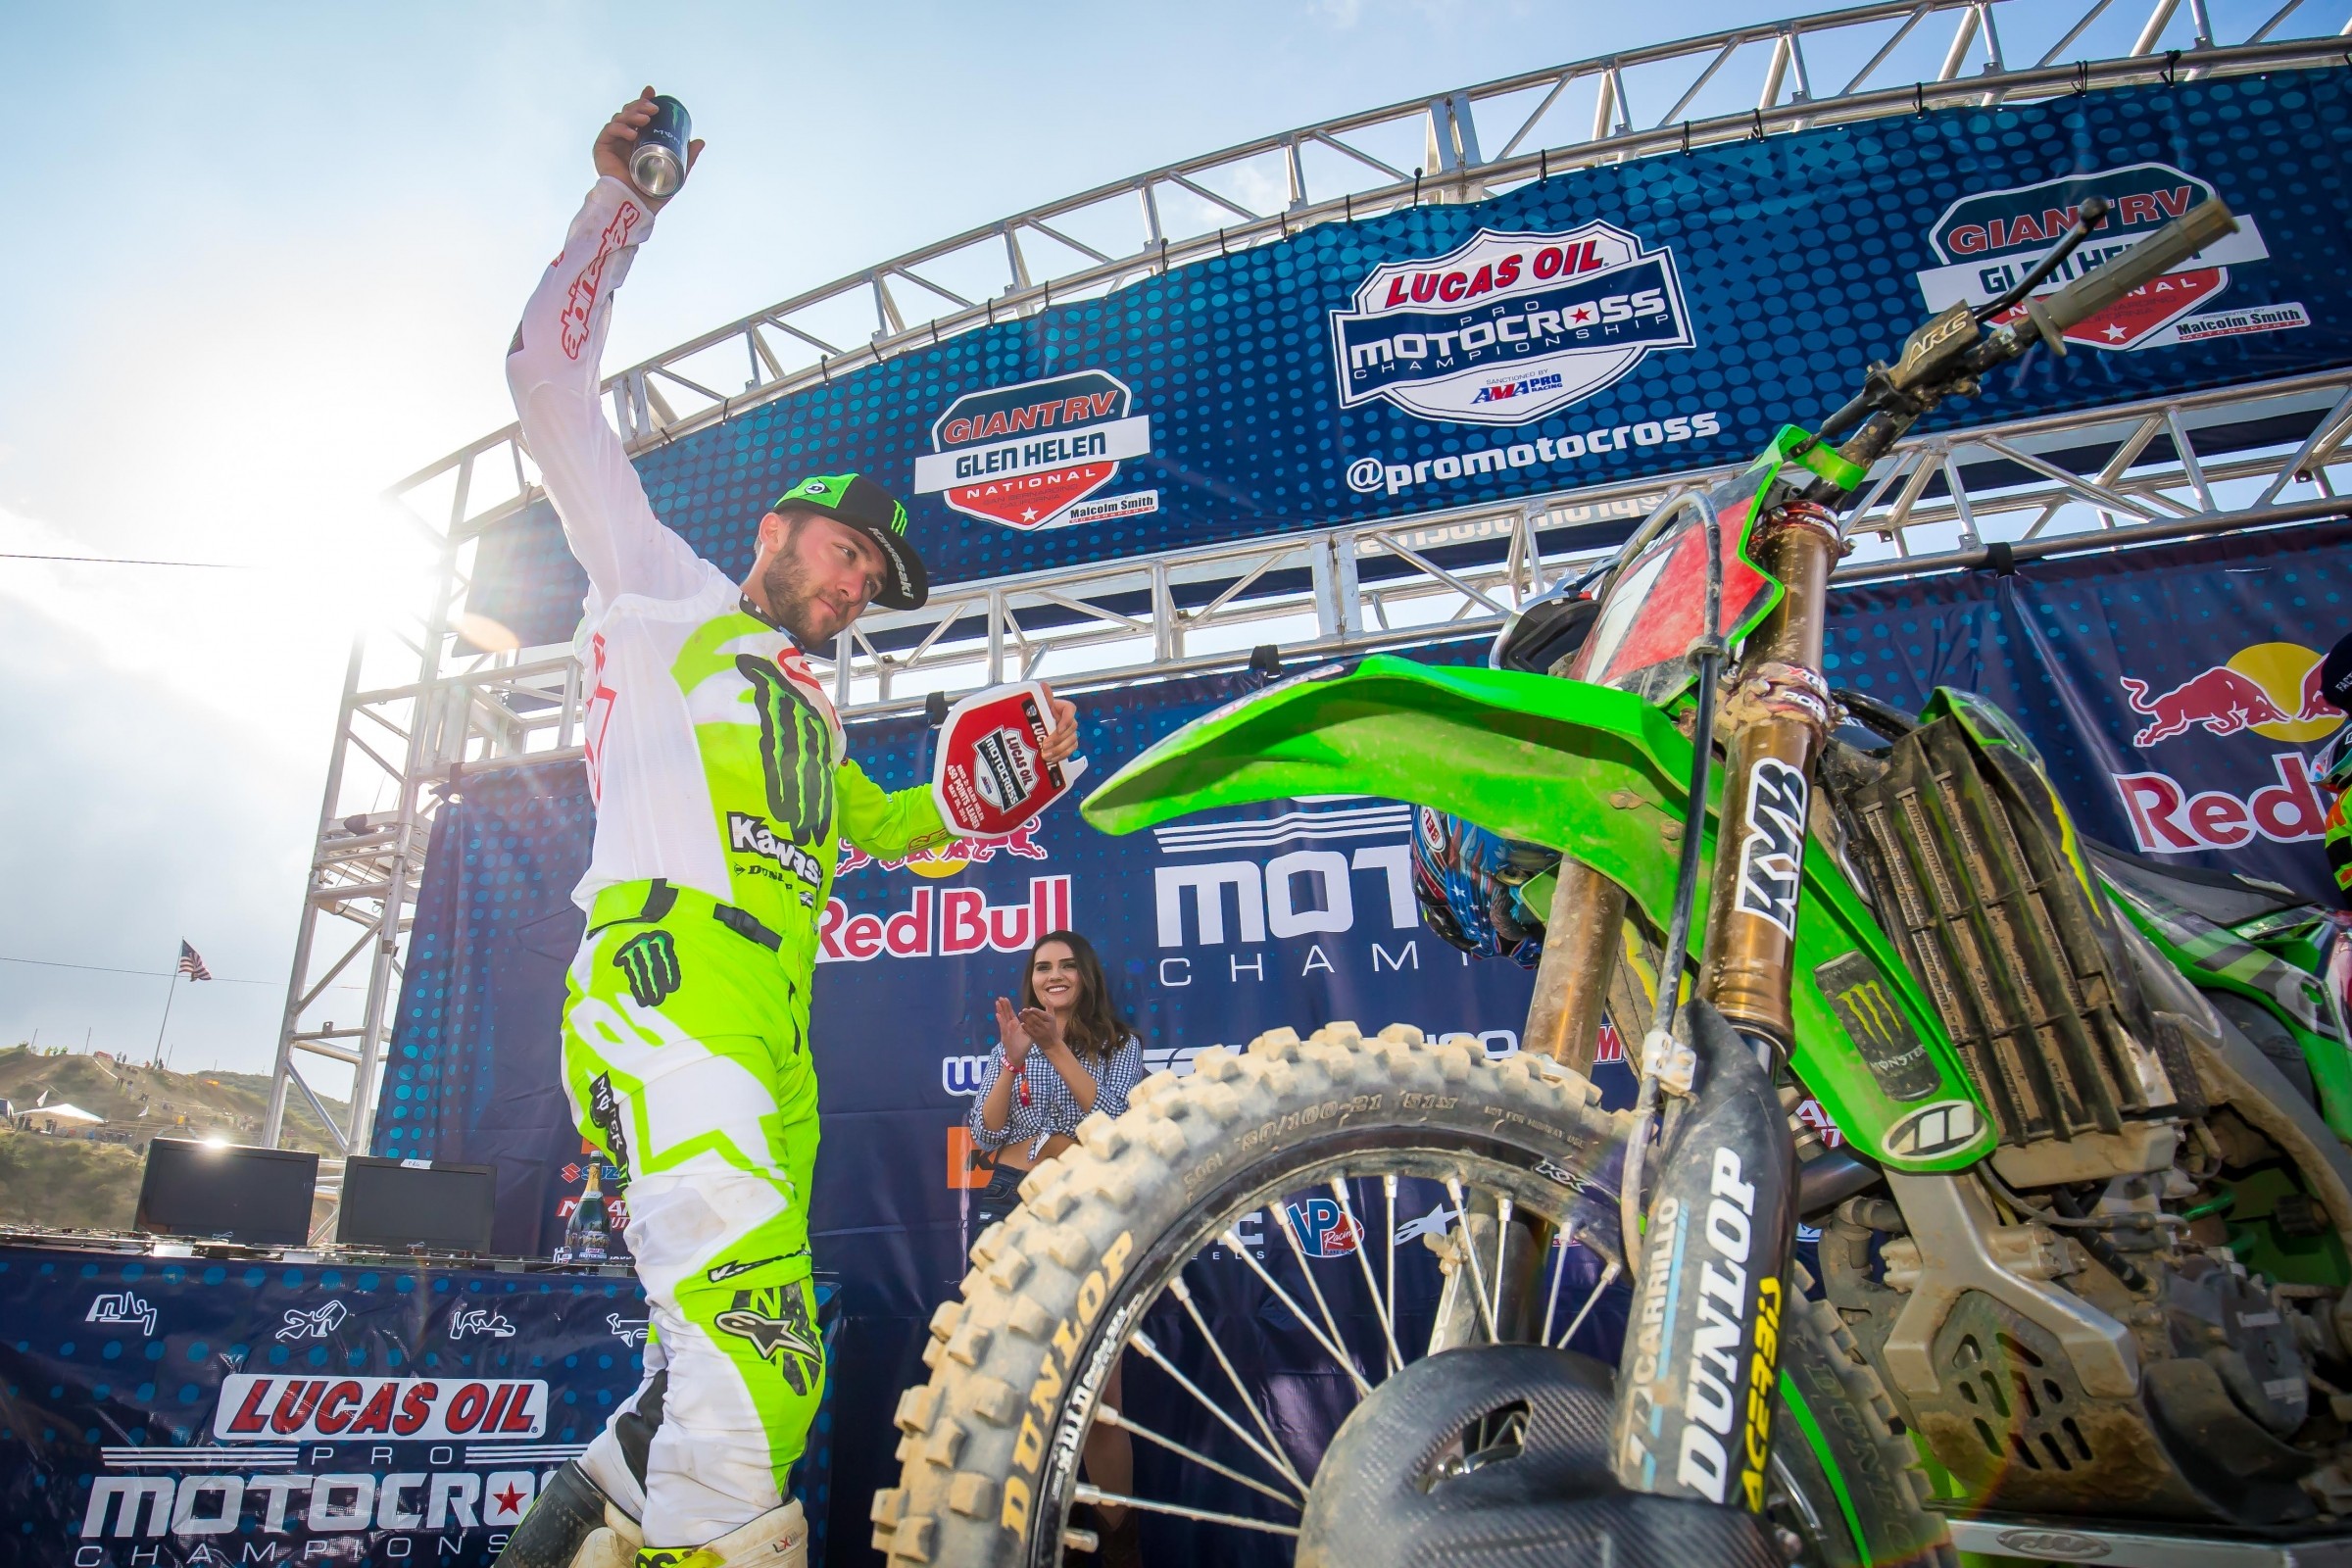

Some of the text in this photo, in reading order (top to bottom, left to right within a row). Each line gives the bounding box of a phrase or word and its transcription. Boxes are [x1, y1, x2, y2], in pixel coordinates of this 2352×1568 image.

[1385, 239, 1605, 309] LUCAS OIL
[1351, 287, 1666, 369] MOTOCROSS
[1459, 300, 1540, 326] PRO
[2177, 308, 2301, 336] Malcolm Smith
[1353, 314, 1669, 379] CHAMPIONSHIP
[1470, 372, 1562, 405] AMA PRO
[1486, 367, 1549, 385] SANCTIONED BY
[1531, 380, 1563, 393] RACING
[956, 432, 1106, 479] GLEN HELEN
[1346, 412, 1721, 495] @promotocross
[966, 468, 1097, 500] NATIONAL
[1070, 496, 1154, 519] Malcolm Smith
[868, 527, 913, 599] Kawasaki
[986, 735, 1019, 806] MOTOCROSS
[1006, 737, 1033, 786] LUCAS OIL
[947, 764, 980, 830] 450 POINTS LEADER
[948, 784, 957, 799] MAY
[966, 786, 978, 804] GLEN
[973, 802, 985, 821] HELEN
[2112, 753, 2327, 853] Red
[1735, 758, 1808, 941] KYB
[817, 874, 1072, 961] Red Bull
[1286, 1199, 1341, 1256] VP
[1634, 1197, 1679, 1385] CARRILLO
[1678, 1147, 1755, 1503] DUNLOP
[227, 1379, 538, 1436] LUCAS OIL
[1003, 1230, 1134, 1544] DUNLOP
[312, 1446, 454, 1465] PRO
